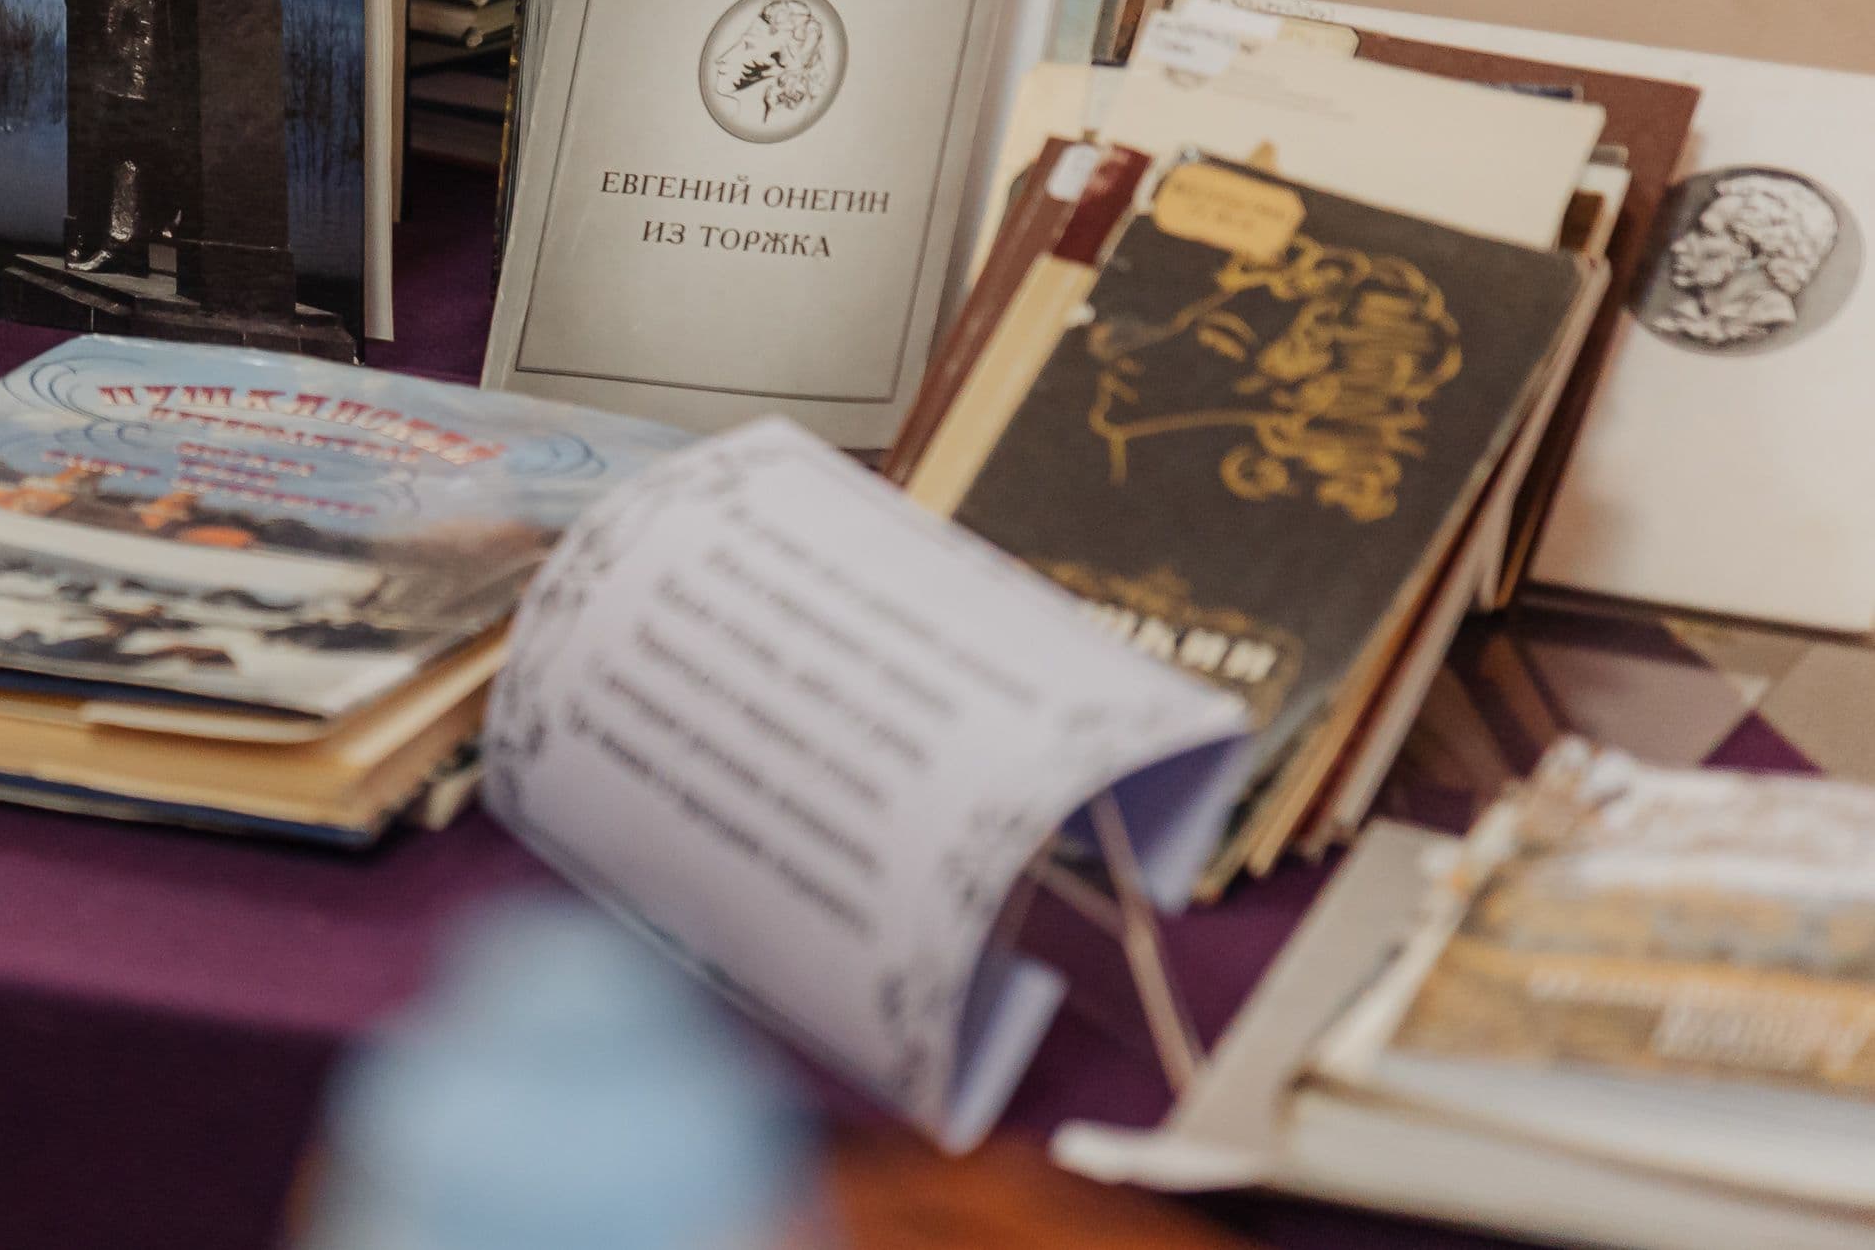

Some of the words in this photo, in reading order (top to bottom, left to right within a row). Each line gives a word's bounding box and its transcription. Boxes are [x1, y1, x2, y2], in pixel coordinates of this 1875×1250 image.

[600, 170, 751, 207] ЕВГЕНИЙ
[763, 184, 891, 214] ОНЕГИН
[641, 220, 686, 245] ИЗ
[700, 225, 832, 258] ТОРЖКА
